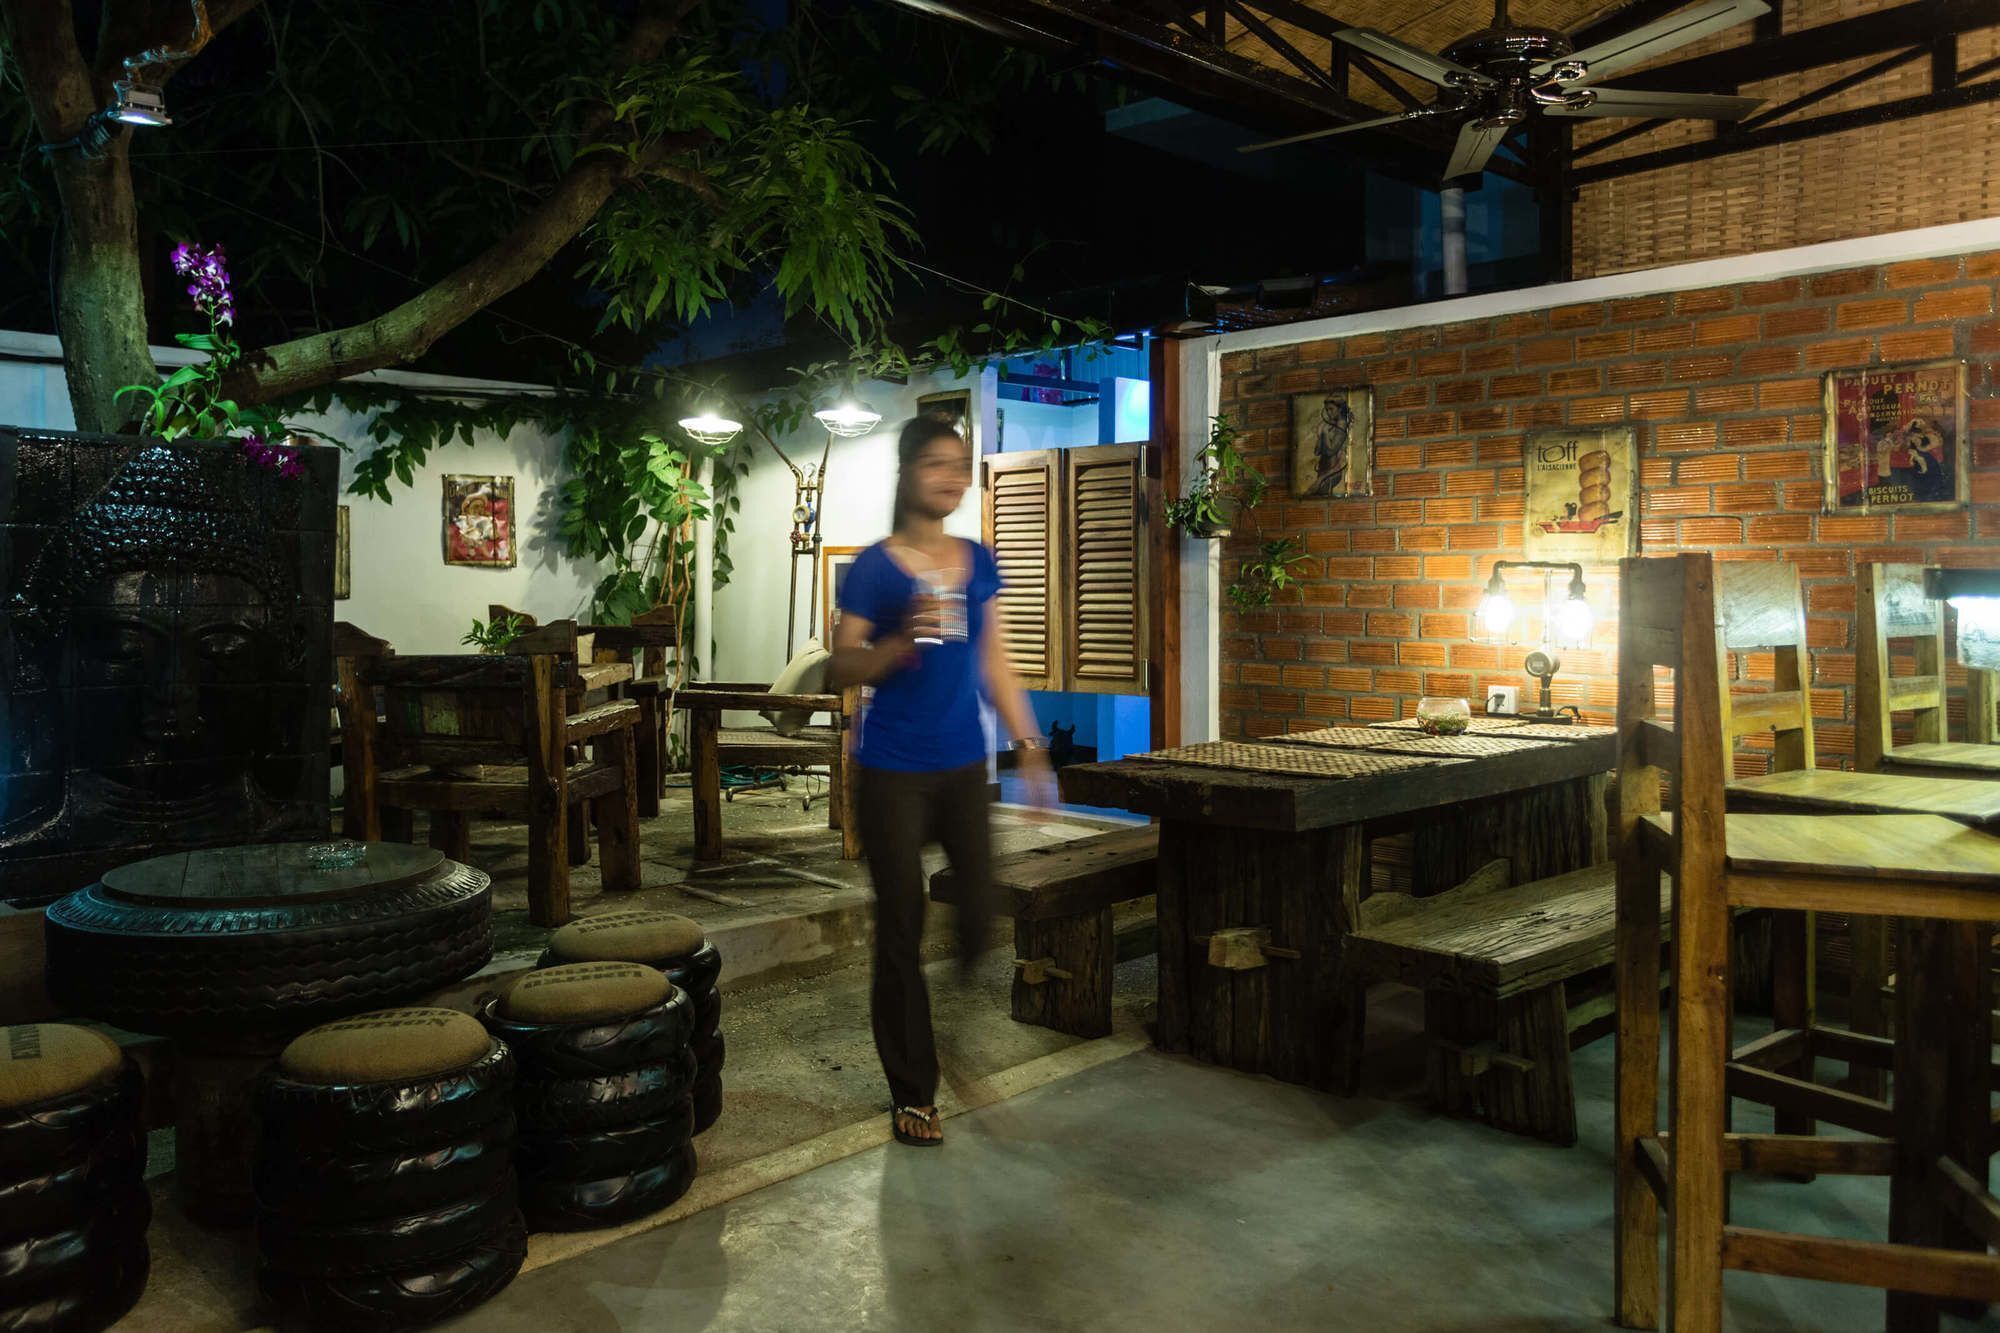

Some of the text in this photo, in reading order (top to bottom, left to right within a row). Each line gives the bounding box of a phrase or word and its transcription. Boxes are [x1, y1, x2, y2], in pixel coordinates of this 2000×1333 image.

[1844, 375, 1896, 387] PAQUET
[1883, 379, 1951, 394] PERNOT
[1868, 485, 1908, 495] BISCUITS
[1871, 493, 1914, 504] PERNOT
